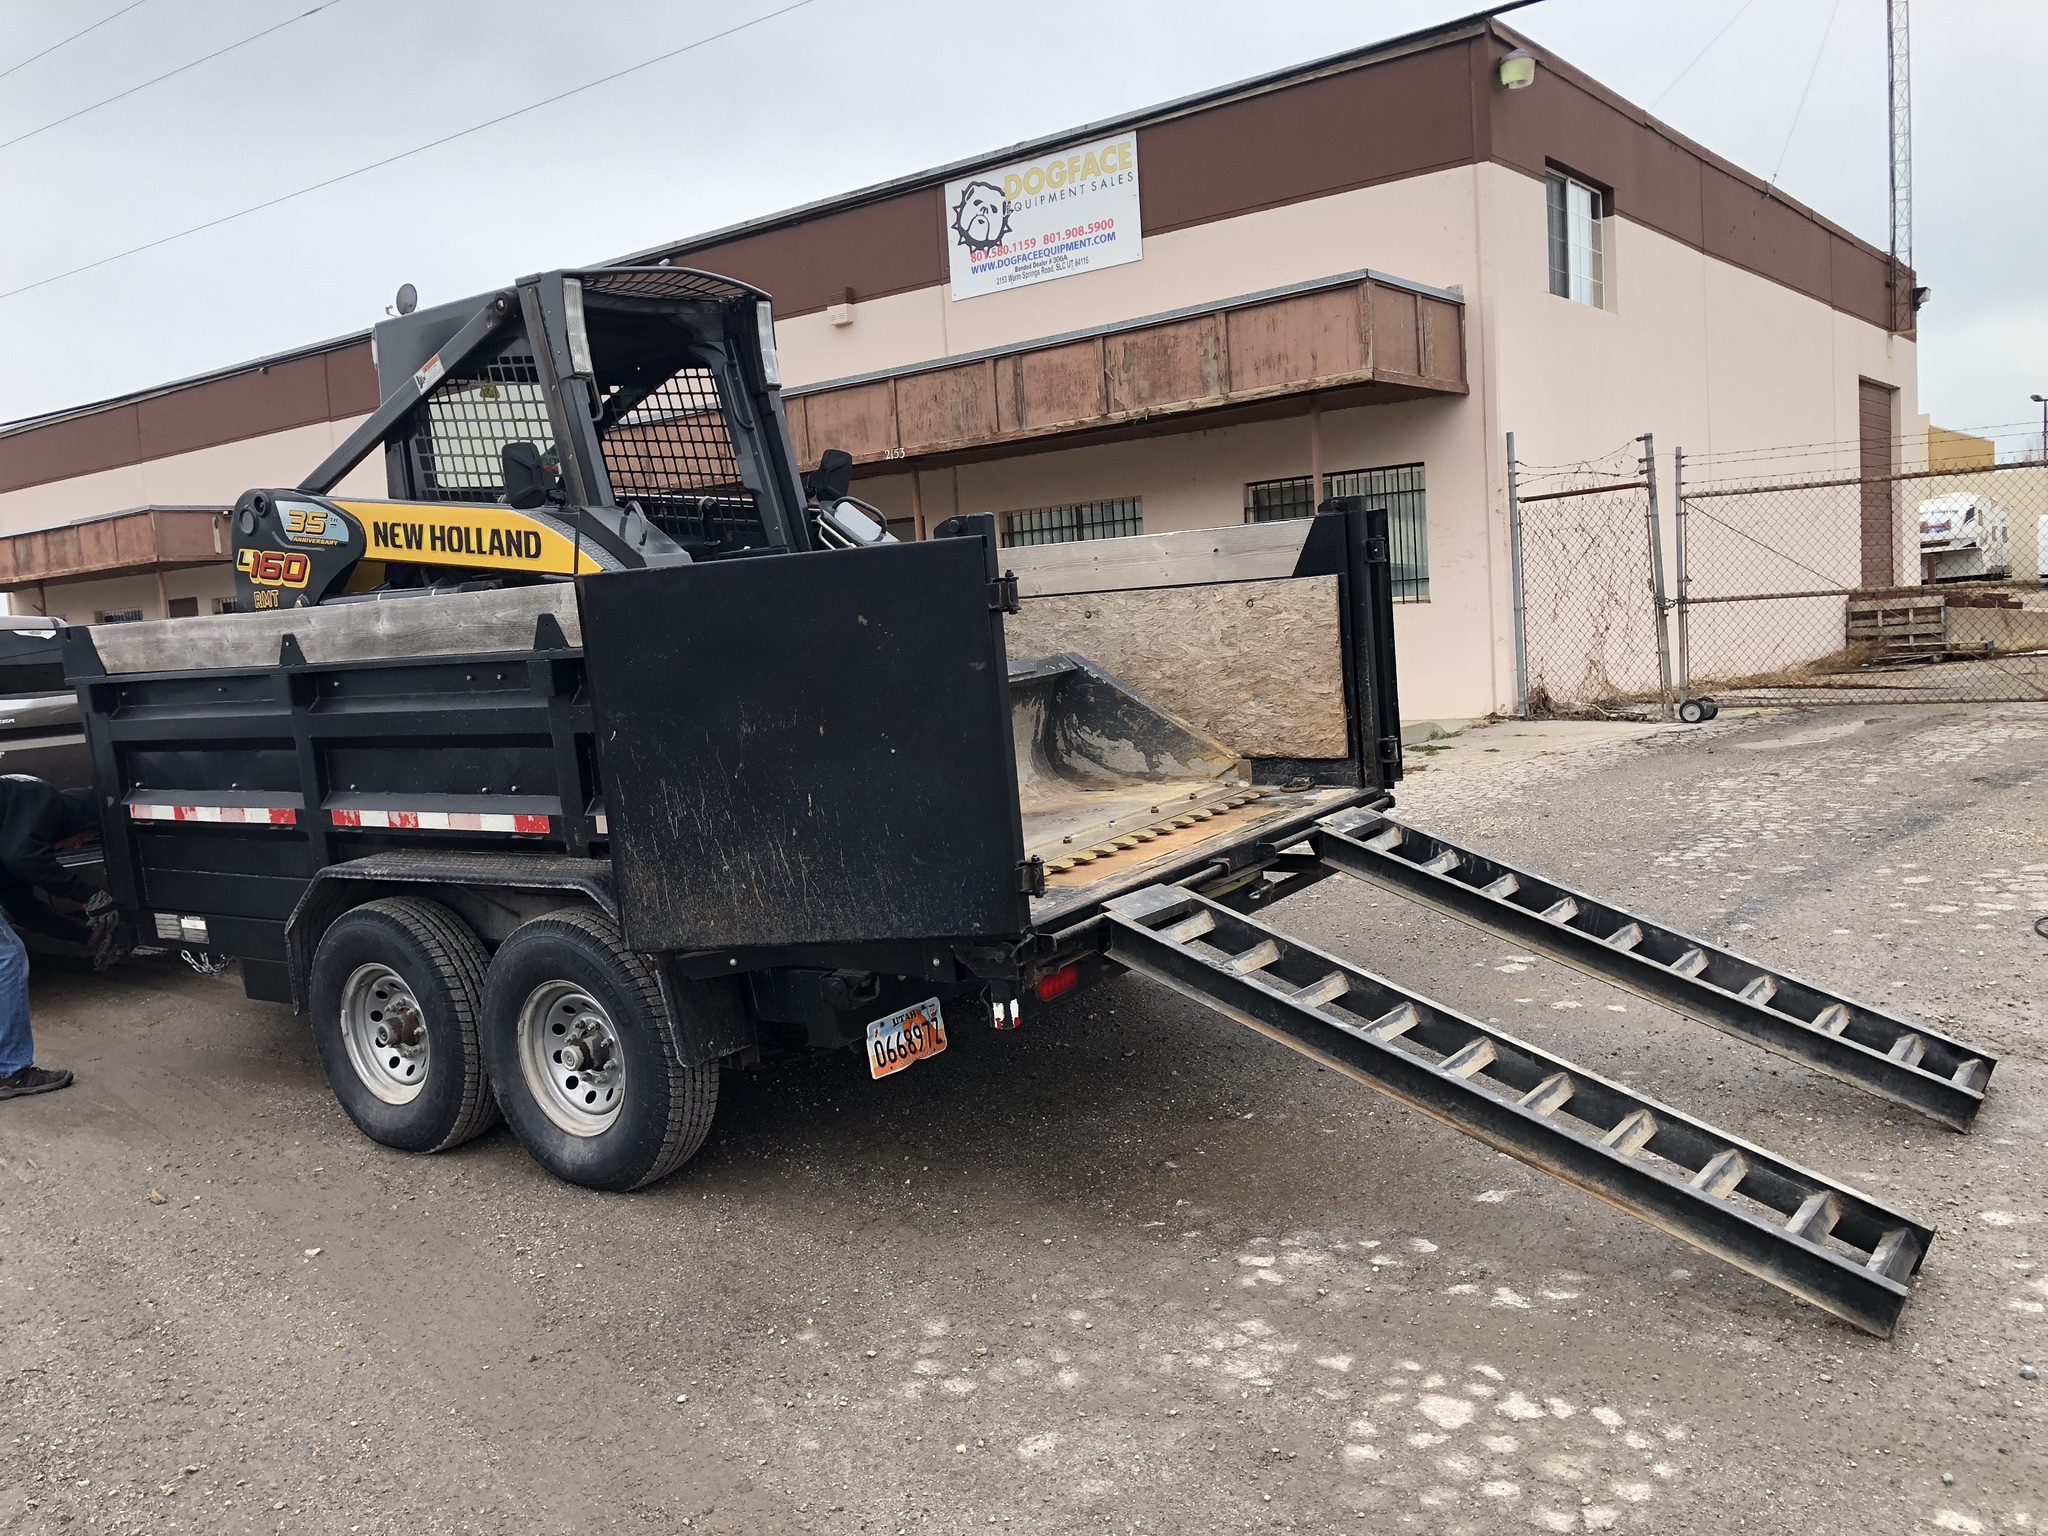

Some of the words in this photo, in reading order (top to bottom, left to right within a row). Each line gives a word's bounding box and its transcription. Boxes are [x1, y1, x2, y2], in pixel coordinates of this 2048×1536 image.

[1004, 141, 1132, 201] DOGFACE
[1006, 184, 1085, 215] EQUIPMENT
[1091, 172, 1133, 192] SALES
[970, 238, 1037, 263] 801.580.1159
[1043, 218, 1114, 245] 801.908.5900
[970, 232, 1116, 275] WWW.DOGFACEEQUIPMENT.COM
[996, 276, 1008, 285] 2153
[1022, 268, 1040, 280] Springs
[1055, 262, 1066, 271] SLC
[1066, 260, 1074, 269] UT
[1074, 256, 1089, 267] 84116
[1014, 263, 1032, 273] Bonded
[1032, 259, 1048, 269] Dealer
[884, 447, 906, 460] 2153
[292, 536, 339, 546] ANNIVERSARY
[372, 521, 424, 550] NEW
[429, 524, 542, 559] HOLLAND
[237, 549, 309, 586] L160
[891, 1010, 917, 1027] UTAH
